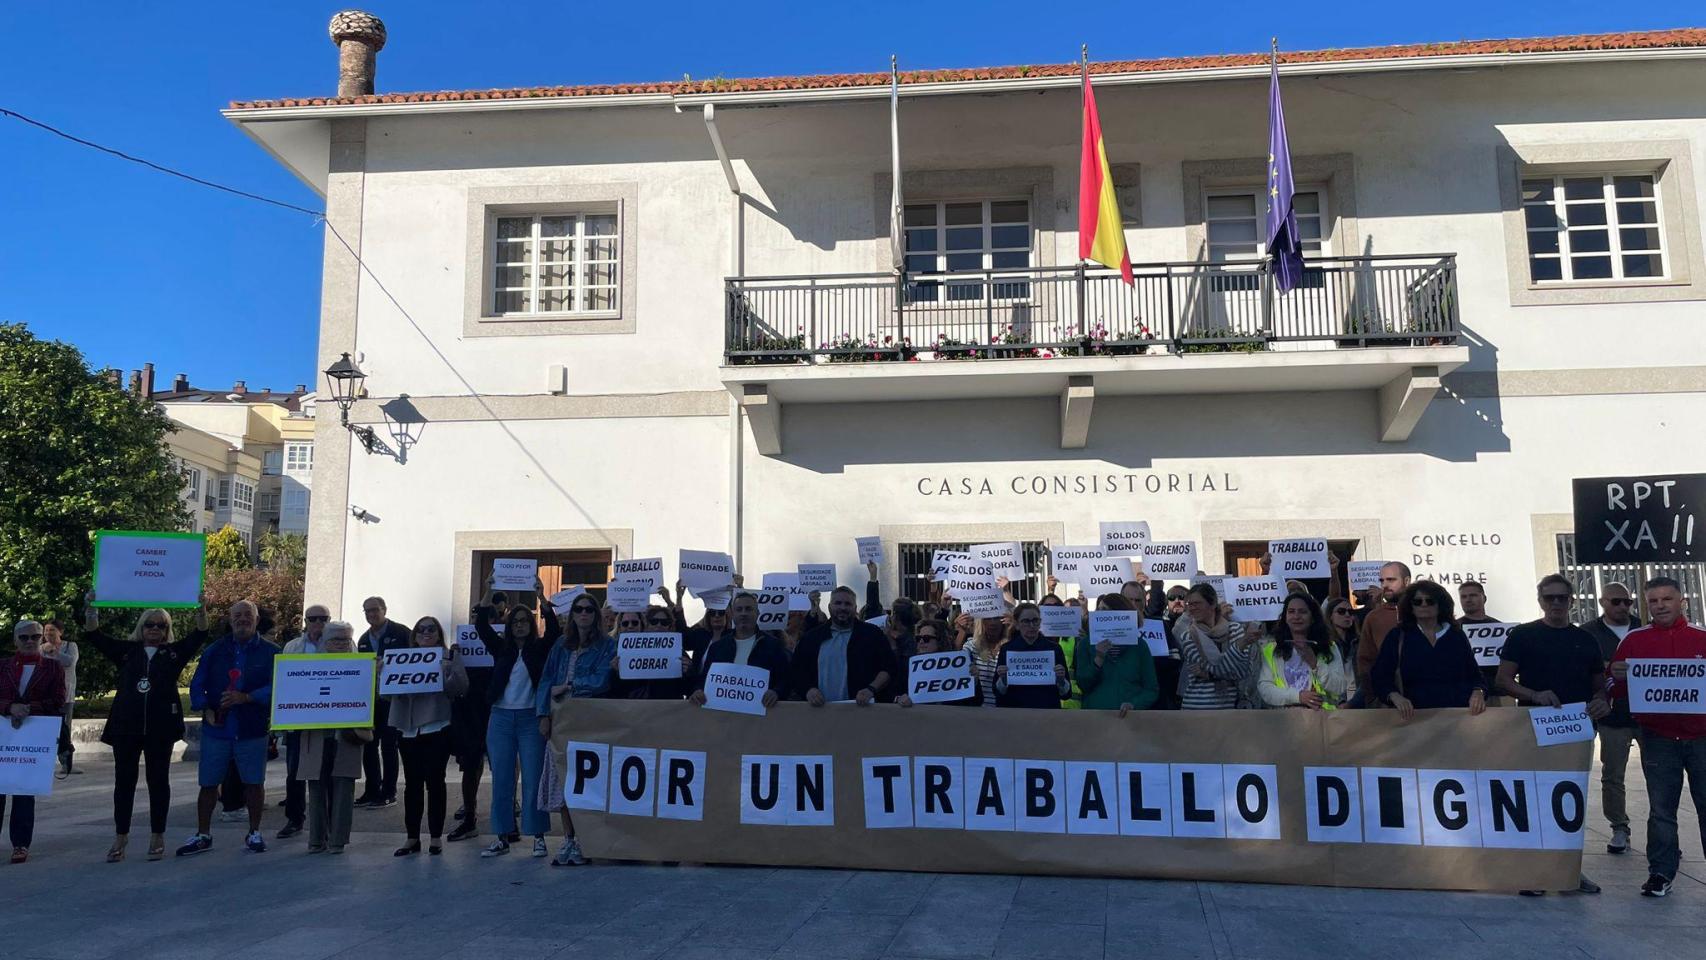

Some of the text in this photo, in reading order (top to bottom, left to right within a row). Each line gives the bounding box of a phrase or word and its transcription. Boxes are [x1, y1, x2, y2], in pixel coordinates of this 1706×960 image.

[918, 473, 1238, 495] CASA CONSISTORIAL
[1106, 532, 1145, 540] SOLDOS
[1411, 534, 1501, 547] CONCELLO
[135, 548, 167, 556] CAMBRE
[981, 548, 1013, 558] SAUDE
[1144, 545, 1190, 555] QUEREMOS
[1271, 542, 1324, 553] TRABALLO
[1057, 551, 1103, 559] COIDADO
[1413, 554, 1434, 565] DE
[615, 561, 660, 573] TRABALLO
[681, 562, 729, 573] DIGNIDADE
[951, 564, 992, 576] SOLDOS
[991, 560, 1020, 569] ORAL
[1093, 564, 1119, 572] VIDA
[1151, 562, 1186, 573] COBRAR
[1284, 560, 1318, 571] DIGNO
[951, 580, 992, 590] DIGNOS
[1090, 577, 1123, 585] DIGNA
[1238, 582, 1278, 592] SAUDE
[754, 594, 785, 604] DO
[1235, 596, 1285, 607] MENTAL
[759, 612, 786, 622] OR
[621, 637, 675, 649] QUEREMOS
[384, 652, 437, 665] TODO
[629, 658, 668, 670] COBRAR
[911, 655, 967, 672] TODO
[287, 669, 311, 677] UNIÓN
[1632, 664, 1705, 678] QUEREMOS
[385, 672, 440, 686] PEOR
[710, 673, 765, 689] TRABALLO
[914, 678, 971, 694] PEOR
[716, 688, 755, 702] DIGNO
[1645, 688, 1699, 702] COBRAR
[277, 701, 367, 710] SUBVENCIÓN PERDIDA
[1534, 712, 1587, 726] TRABALLO
[1546, 723, 1582, 736] DIGNO
[573, 750, 1585, 833] POR UN TRABALLO DIGNO
